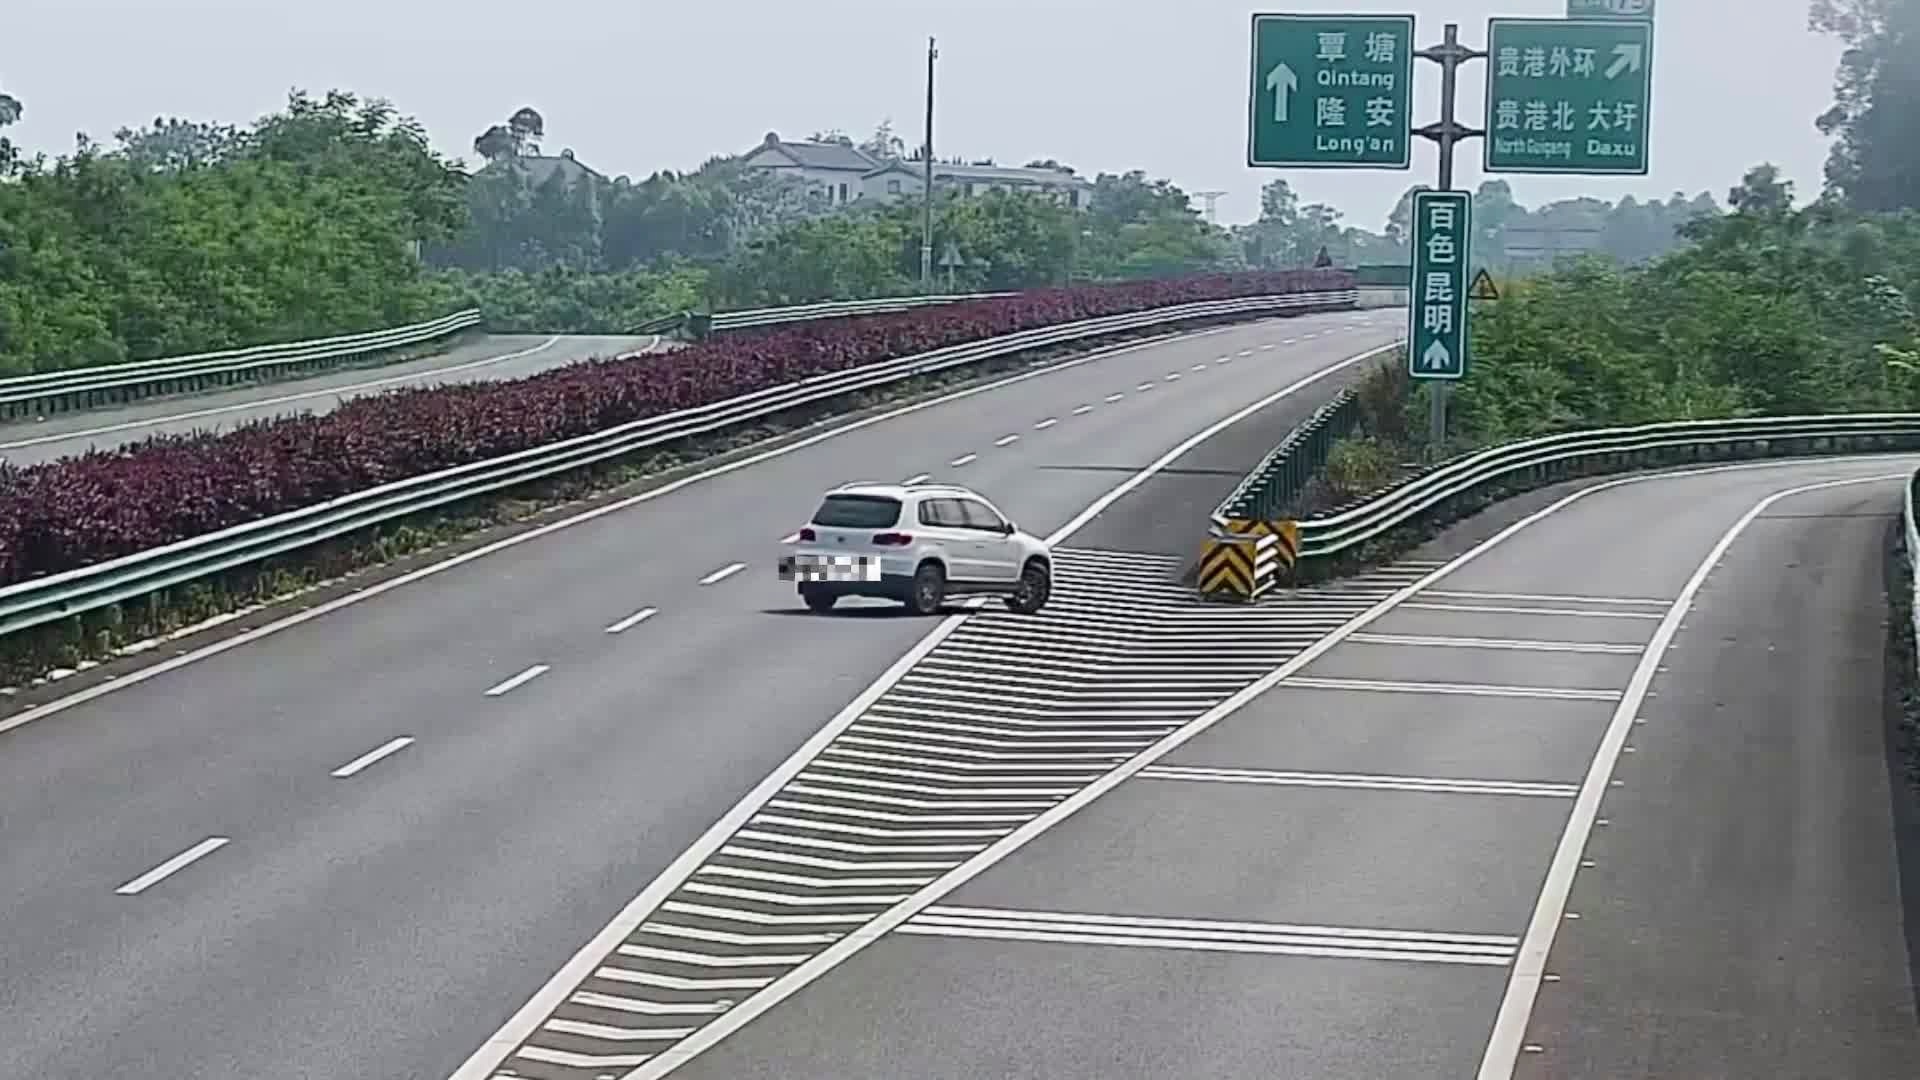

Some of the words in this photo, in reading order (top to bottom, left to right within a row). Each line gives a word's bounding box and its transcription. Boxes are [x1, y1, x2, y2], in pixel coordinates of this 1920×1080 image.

[1316, 32, 1397, 63] 覃塘
[1497, 46, 1596, 78] 贵港外环
[1317, 70, 1394, 91] Qintang
[1316, 97, 1394, 127] 隆安
[1495, 100, 1575, 131] 贵港北
[1587, 101, 1638, 131] 大圩
[1316, 135, 1394, 155] Long'an
[1587, 140, 1635, 157] Daxu
